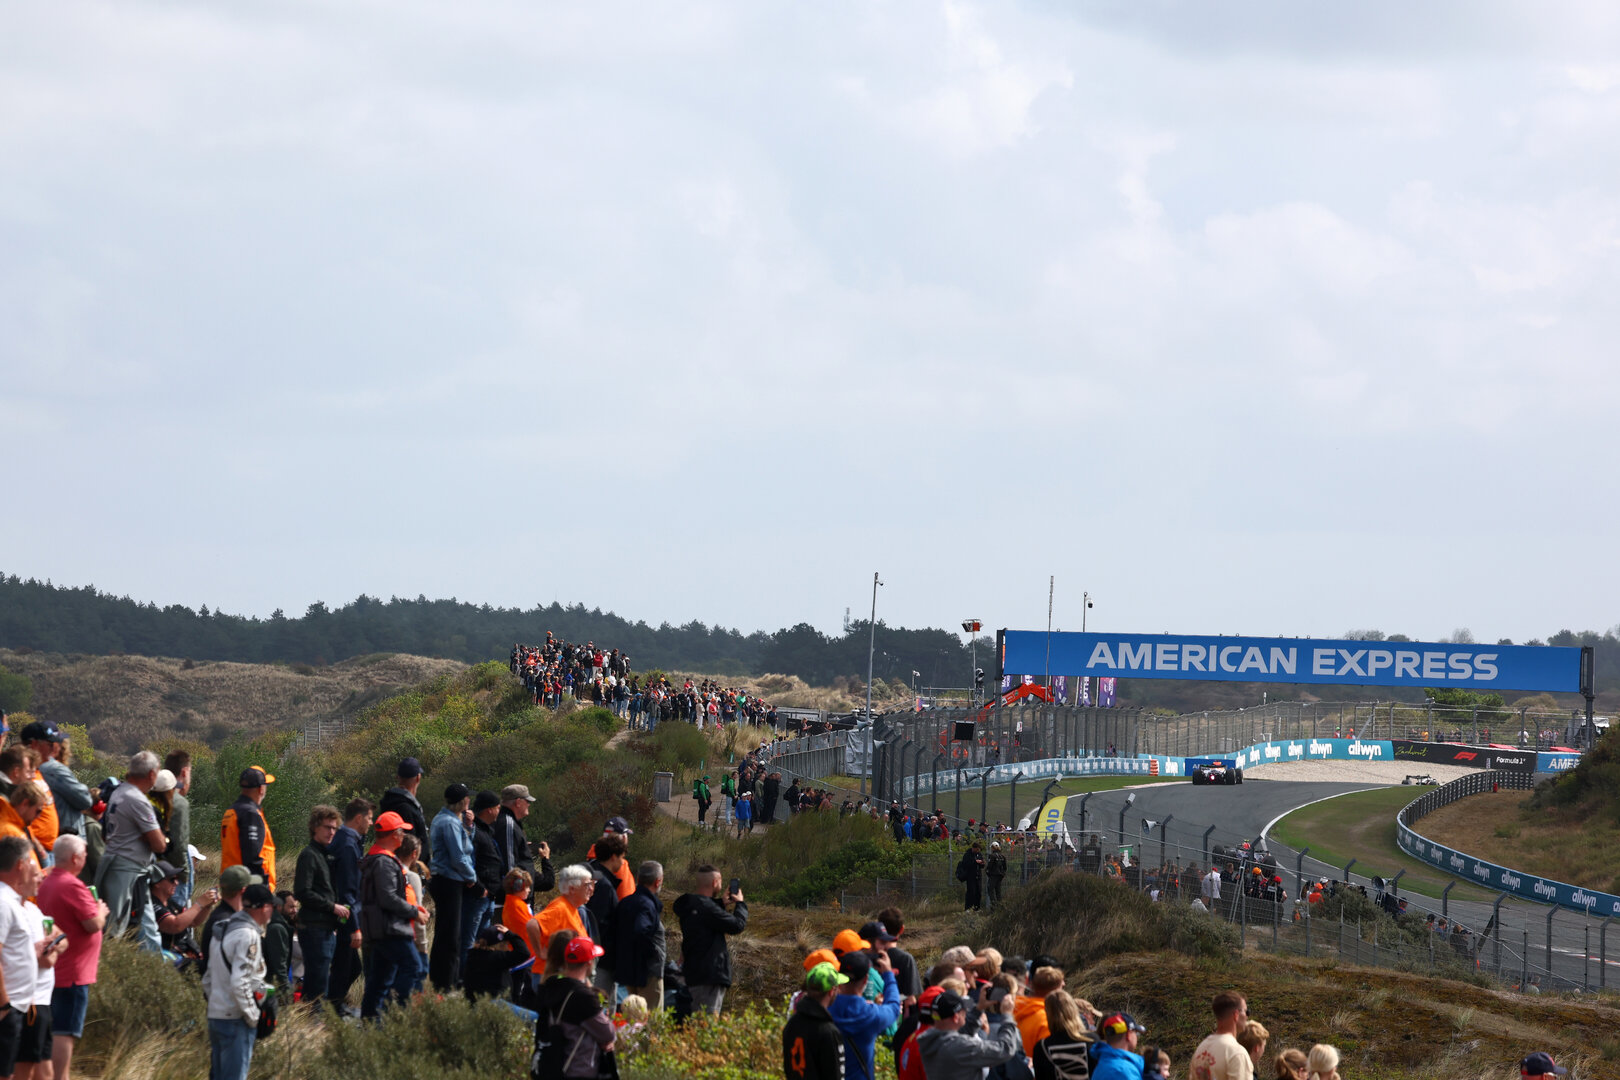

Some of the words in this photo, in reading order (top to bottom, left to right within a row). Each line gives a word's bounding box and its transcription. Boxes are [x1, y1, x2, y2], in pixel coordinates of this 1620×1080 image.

[1086, 642, 1297, 674] AMERICAN
[1312, 648, 1498, 681] EXPRESS
[1348, 740, 1381, 760] allwyn
[1496, 756, 1519, 764] Formula
[1534, 879, 1557, 900] allwyn
[1571, 889, 1597, 908] allwyn
